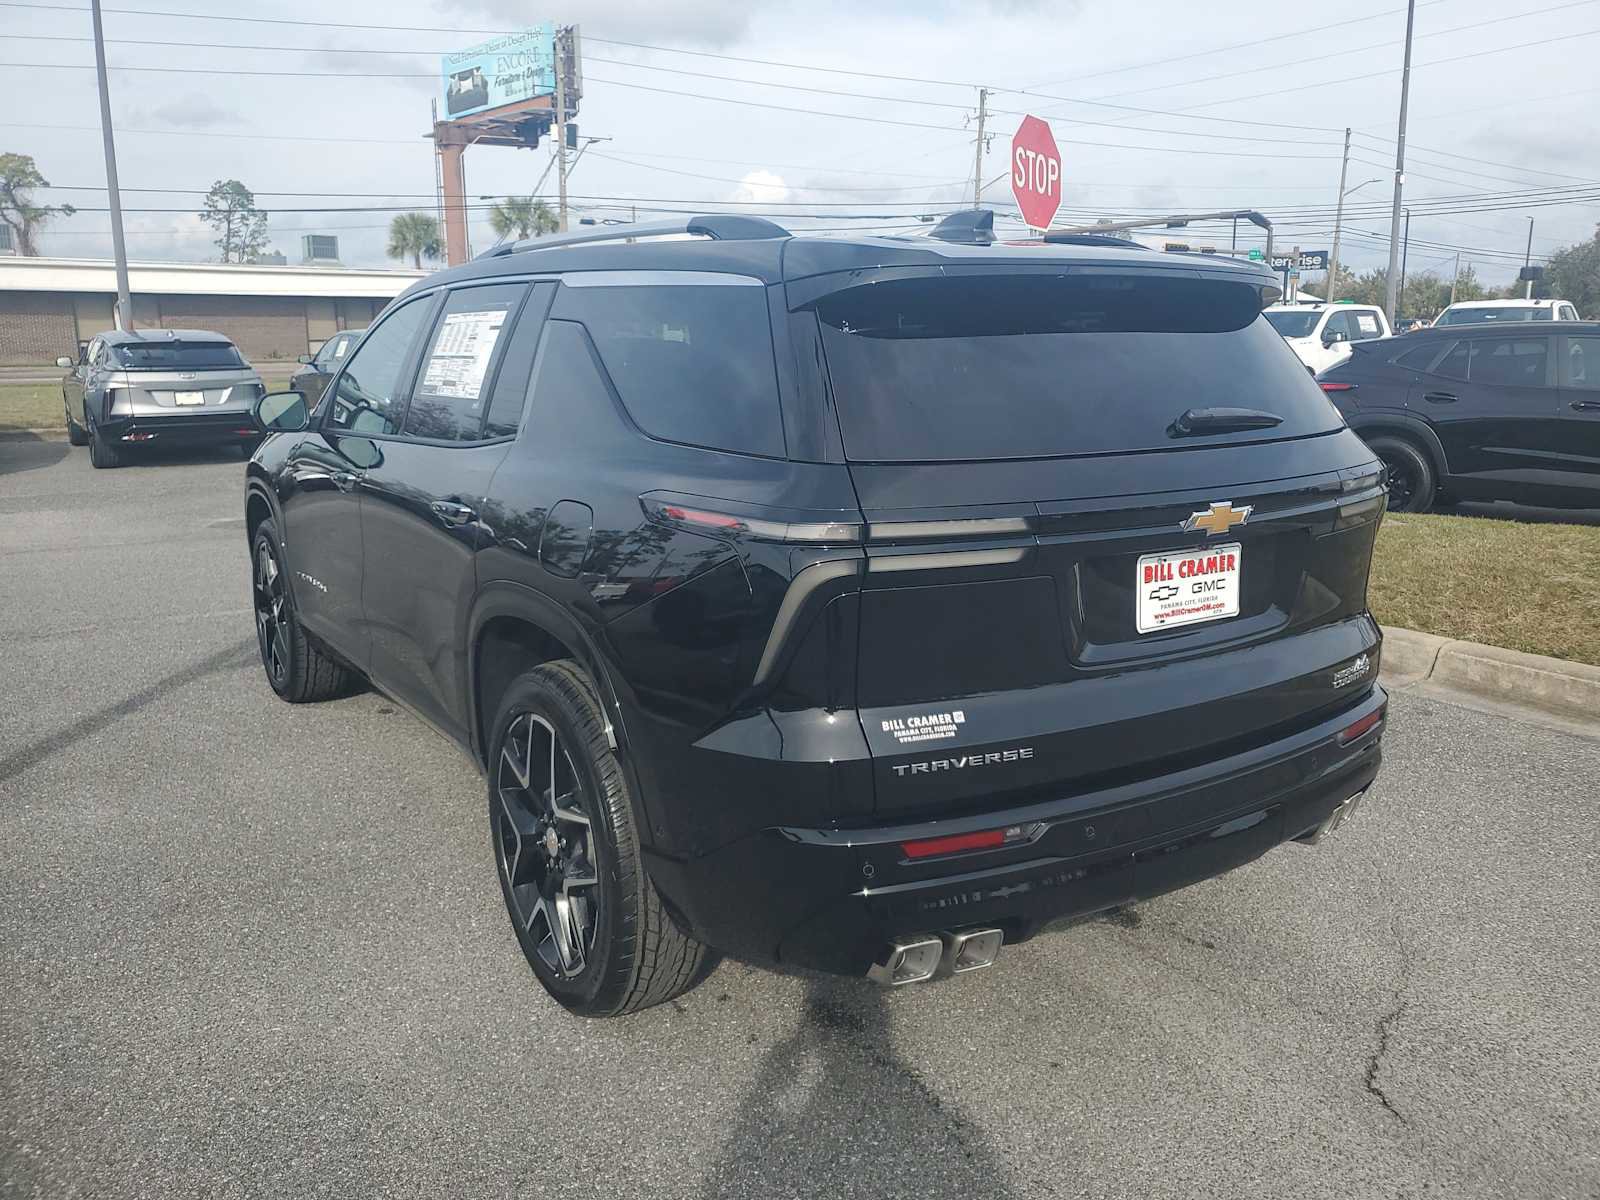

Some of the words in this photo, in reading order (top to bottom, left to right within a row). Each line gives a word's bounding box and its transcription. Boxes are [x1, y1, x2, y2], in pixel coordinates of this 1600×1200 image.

[497, 47, 540, 73] ENCORE
[1014, 146, 1059, 197] STOP
[1144, 563, 1173, 583] BILL
[1178, 554, 1235, 578] CRAMER
[1191, 579, 1226, 594] GMC
[1160, 601, 1183, 610] PANAMA
[1198, 595, 1218, 604] FLORIDA
[881, 718, 904, 731] BILL
[907, 713, 952, 728] CRAMER
[894, 727, 919, 738] PANAMA
[934, 723, 958, 733] FLORIDA
[892, 748, 1033, 776] TRAVERSE
